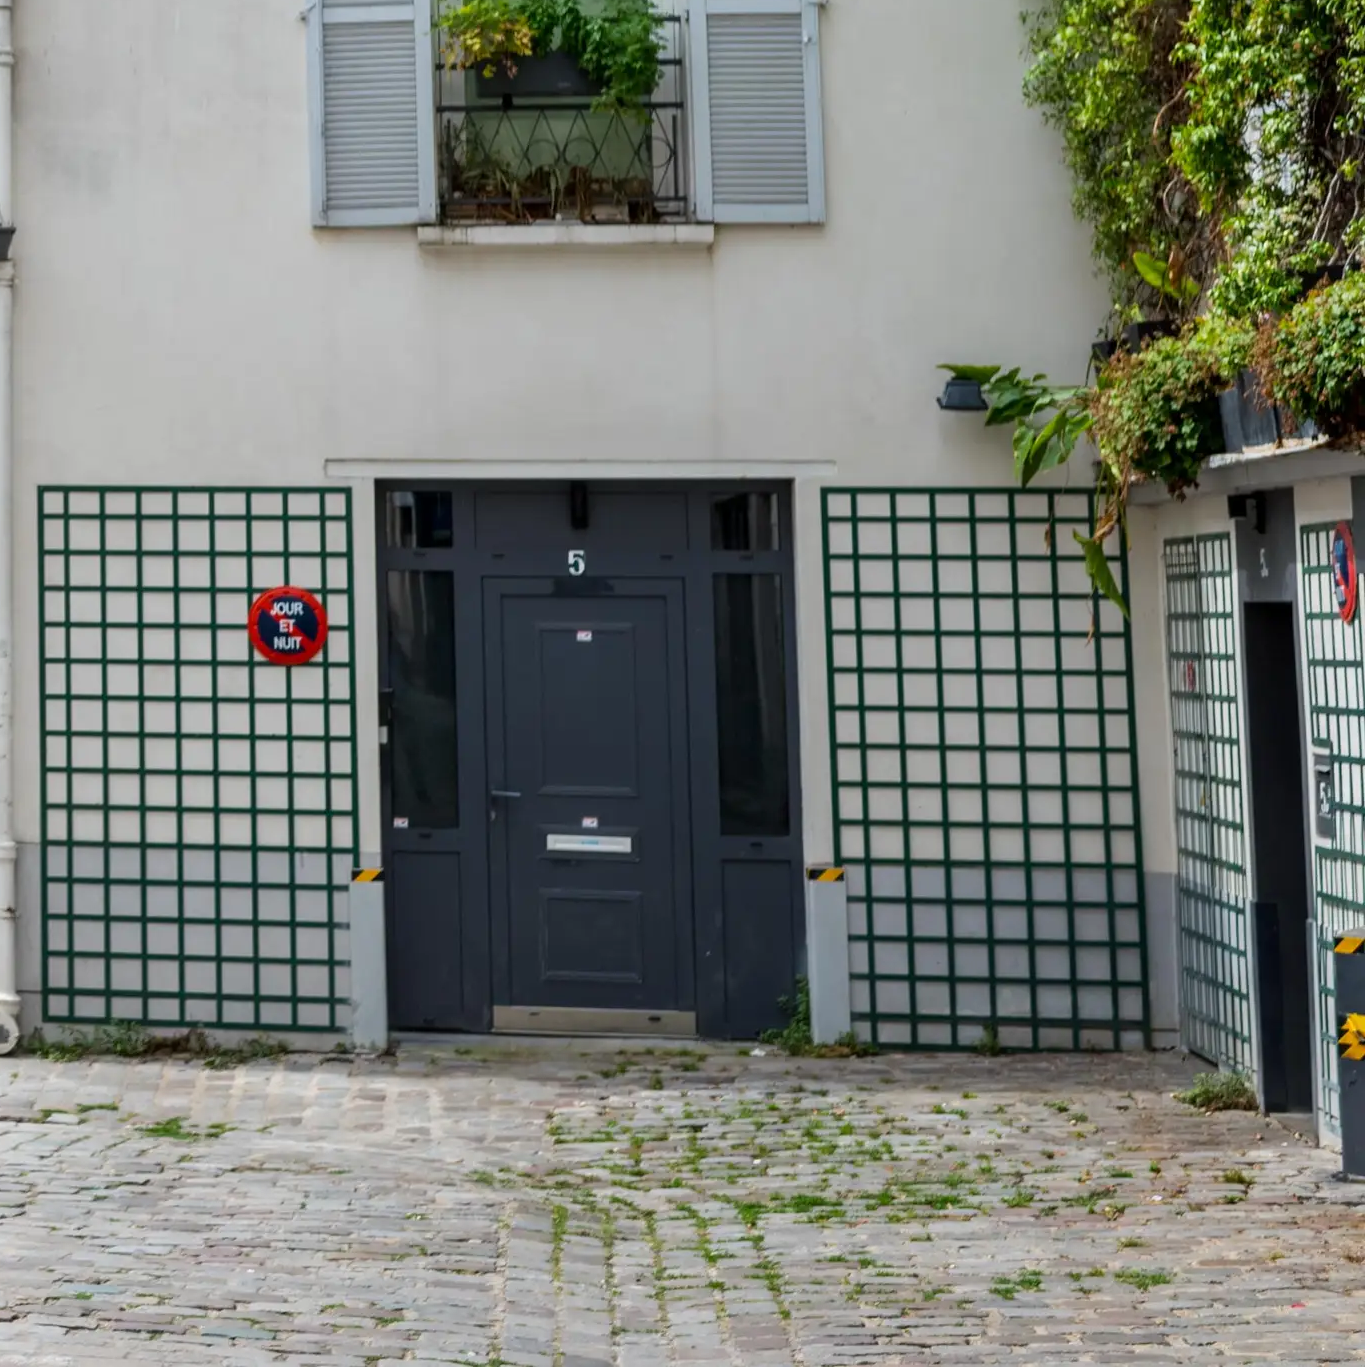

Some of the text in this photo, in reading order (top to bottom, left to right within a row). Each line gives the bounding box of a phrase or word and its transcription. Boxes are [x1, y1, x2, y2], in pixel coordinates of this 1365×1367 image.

[567, 549, 586, 576] 5
[270, 601, 304, 616] JOUR
[278, 618, 296, 634] ET
[273, 635, 303, 650] NUIT
